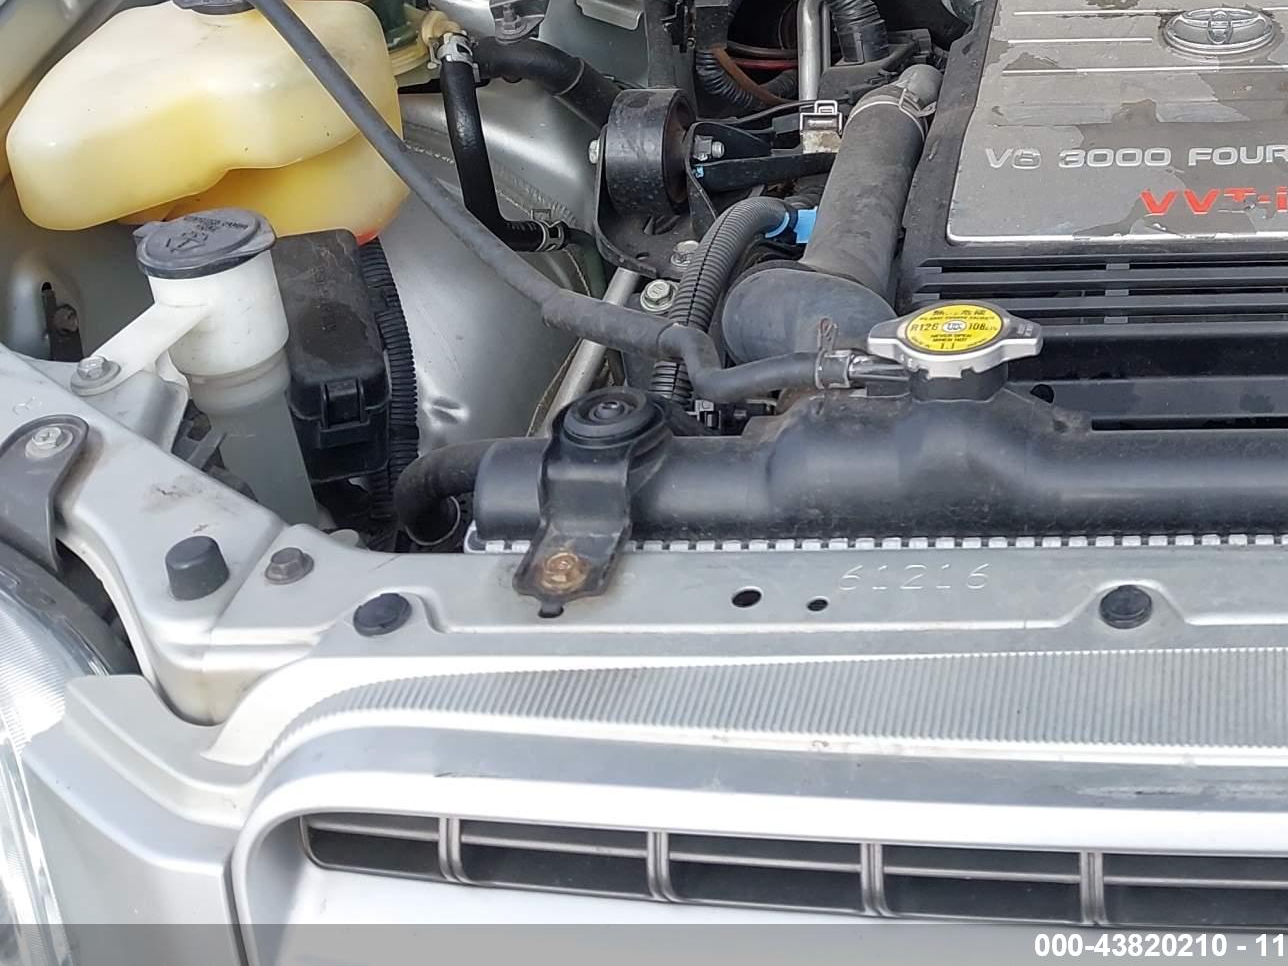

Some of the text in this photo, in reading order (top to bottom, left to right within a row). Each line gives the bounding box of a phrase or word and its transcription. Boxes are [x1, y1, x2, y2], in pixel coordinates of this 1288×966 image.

[1059, 146, 1172, 169] 3000
[1139, 186, 1288, 217] VVT-i
[839, 562, 989, 591] 61216
